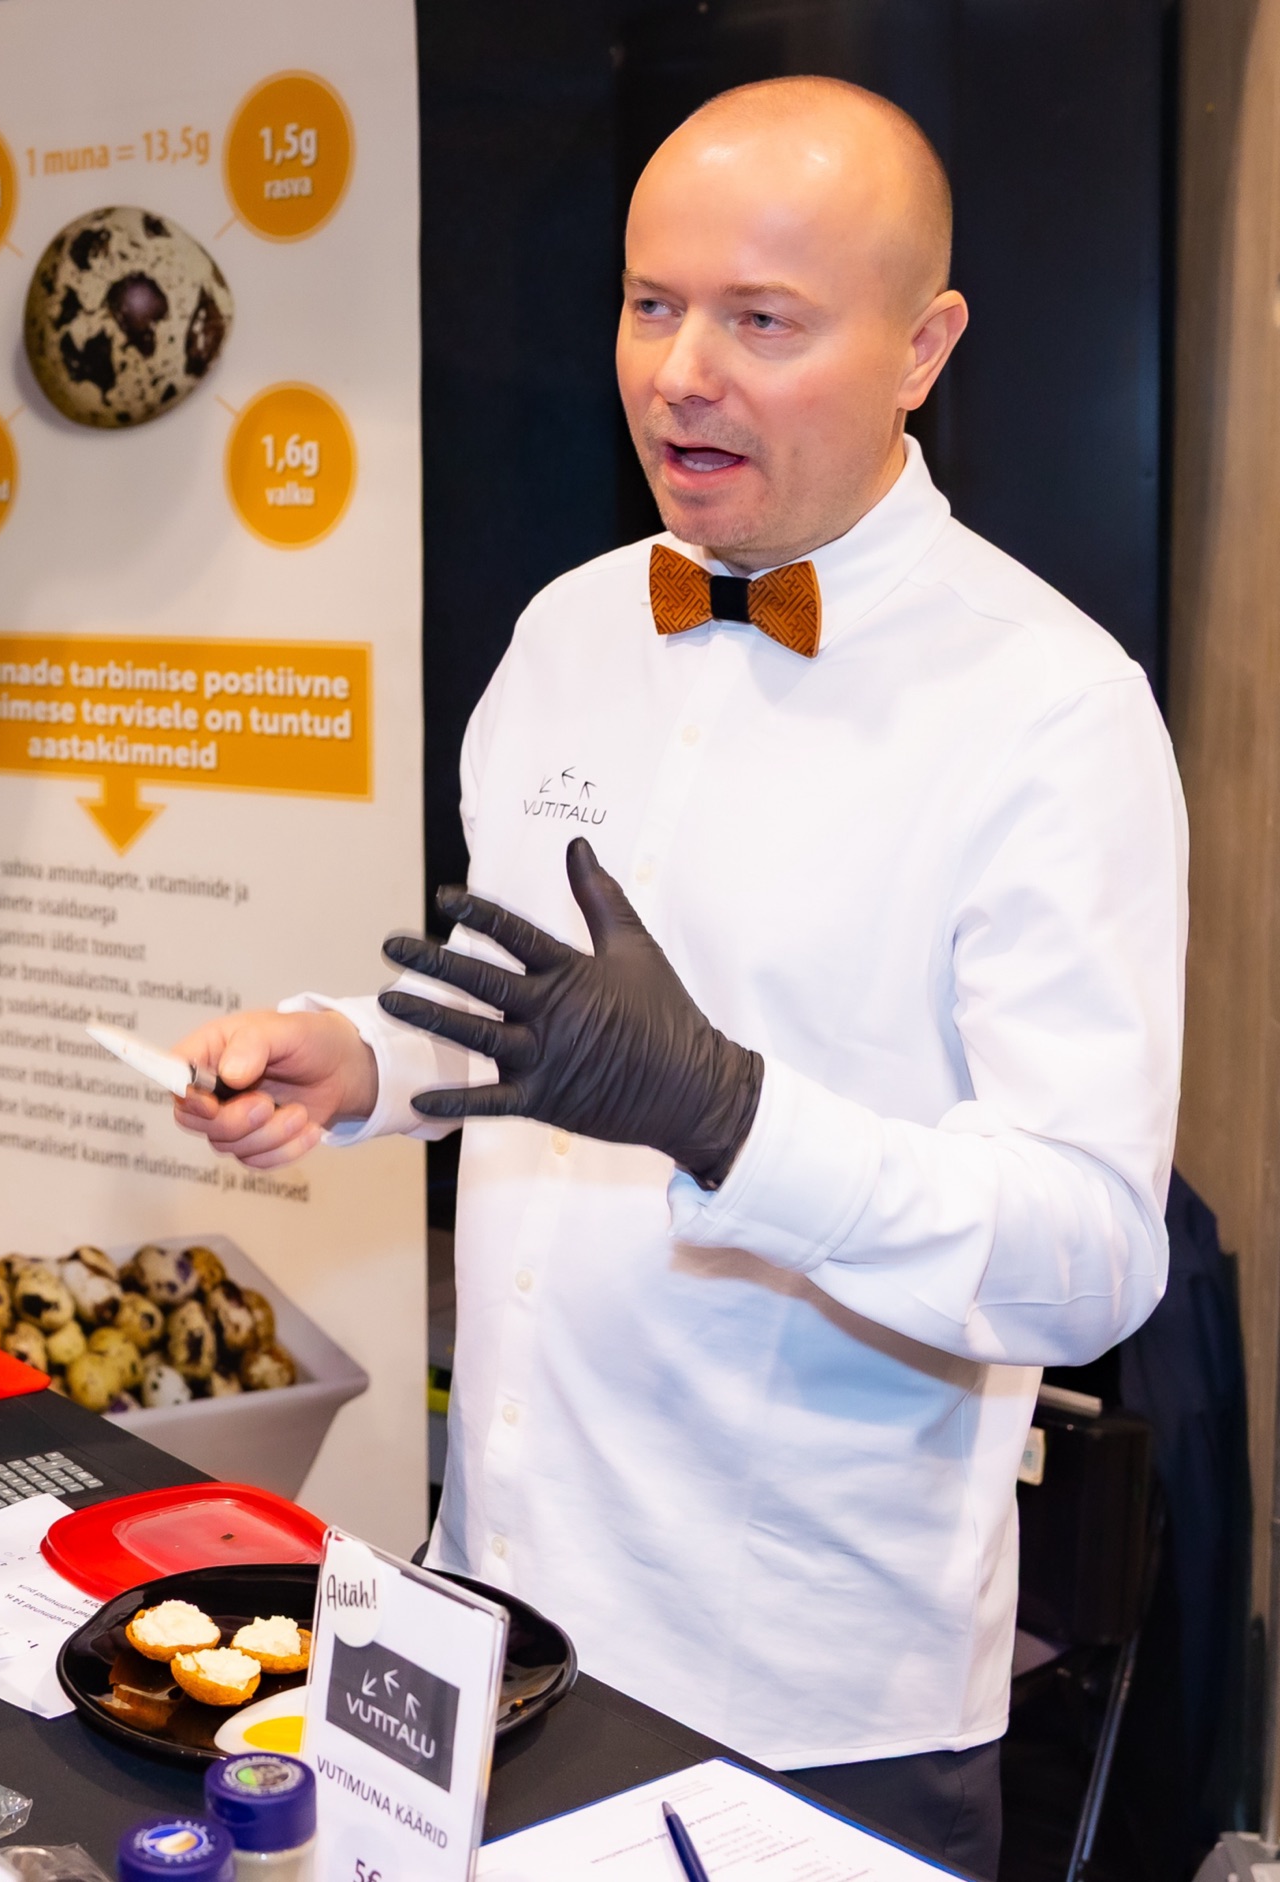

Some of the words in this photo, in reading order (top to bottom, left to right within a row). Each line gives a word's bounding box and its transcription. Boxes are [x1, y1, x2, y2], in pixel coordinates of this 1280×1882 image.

[25, 147, 36, 177] 1
[43, 143, 110, 175] muna
[141, 125, 211, 169] 13,5g
[259, 123, 319, 168] 1,5g
[263, 175, 314, 200] rasva
[260, 433, 320, 477] 1,6g
[265, 482, 316, 507] valku
[69, 660, 198, 693] tarbimise
[202, 665, 350, 700] positiivne
[81, 697, 200, 731] tervisele
[204, 707, 243, 734] on
[248, 708, 352, 740] tuntud
[27, 732, 218, 770] aastakümneid
[523, 799, 607, 825] VUTITALU
[234, 881, 249, 907] ja
[91, 938, 147, 962] toonust
[226, 988, 242, 1013] ja
[69, 1106, 82, 1129] ja
[81, 1142, 128, 1168] kauem
[222, 1170, 237, 1194] ja
[35, 1591, 77, 1615] vutimunad
[326, 1573, 378, 1611] Aitäh!
[23, 1602, 65, 1624] vutimunad
[345, 1691, 437, 1760] VUTITALU
[316, 1754, 392, 1817] VUTIMUNA
[394, 1801, 449, 1851] KÄÄRID
